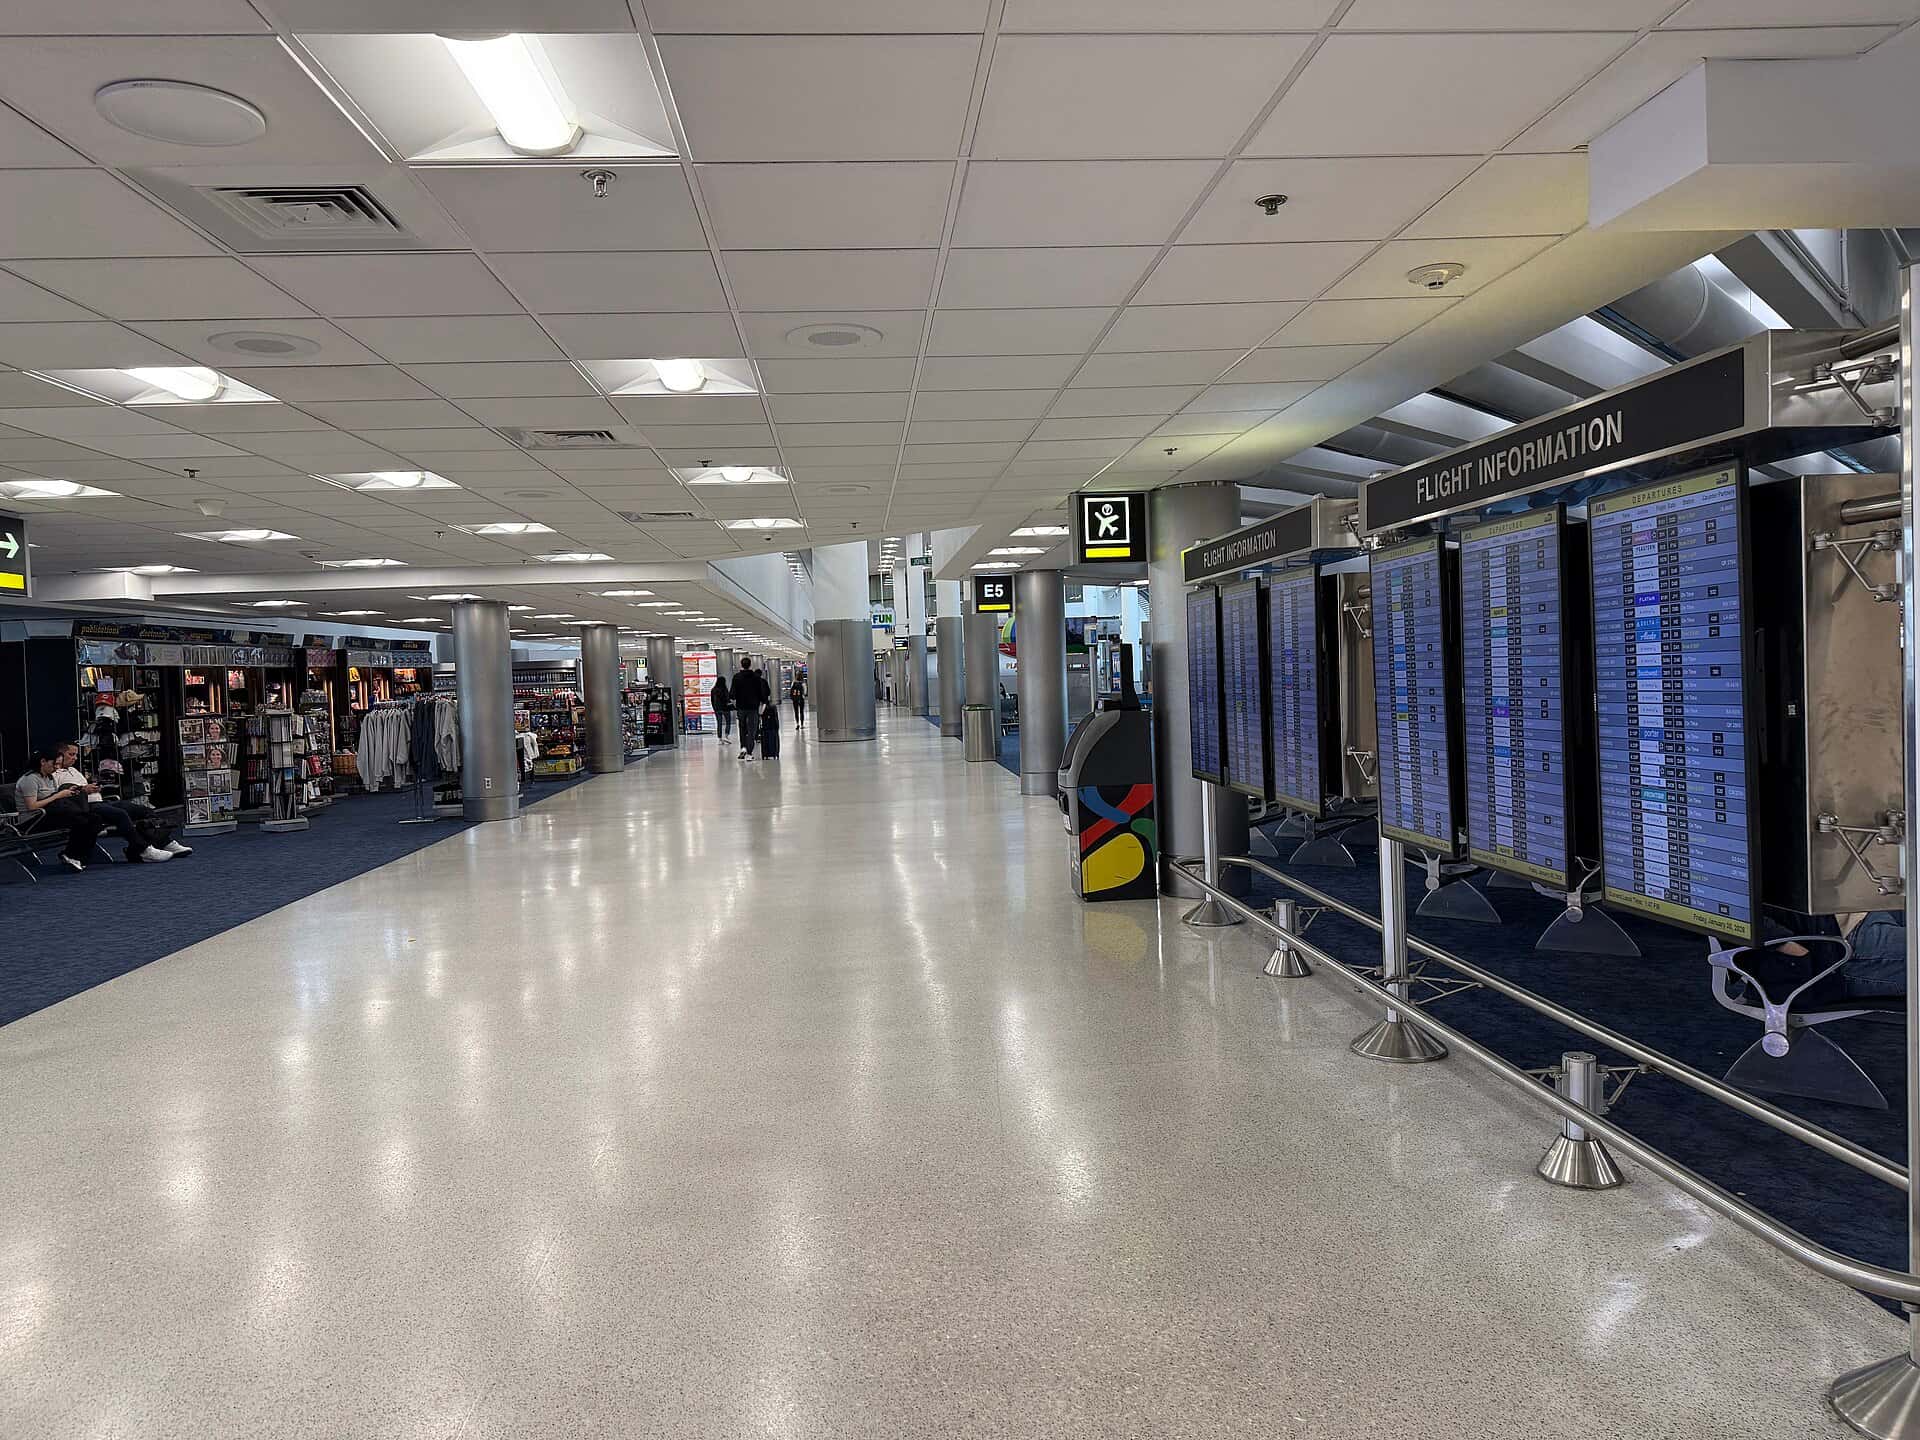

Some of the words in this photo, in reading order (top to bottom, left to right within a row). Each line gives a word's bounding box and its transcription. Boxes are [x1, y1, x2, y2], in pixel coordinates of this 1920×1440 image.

[1416, 462, 1473, 504] FLIGHT
[1478, 410, 1624, 486] INFORMATION
[1632, 485, 1682, 504] DEPARTURES
[1203, 547, 1225, 568] FLIGHT
[1226, 528, 1277, 561] INFORMATION
[984, 584, 1004, 598] E5
[873, 615, 892, 623] FUN
